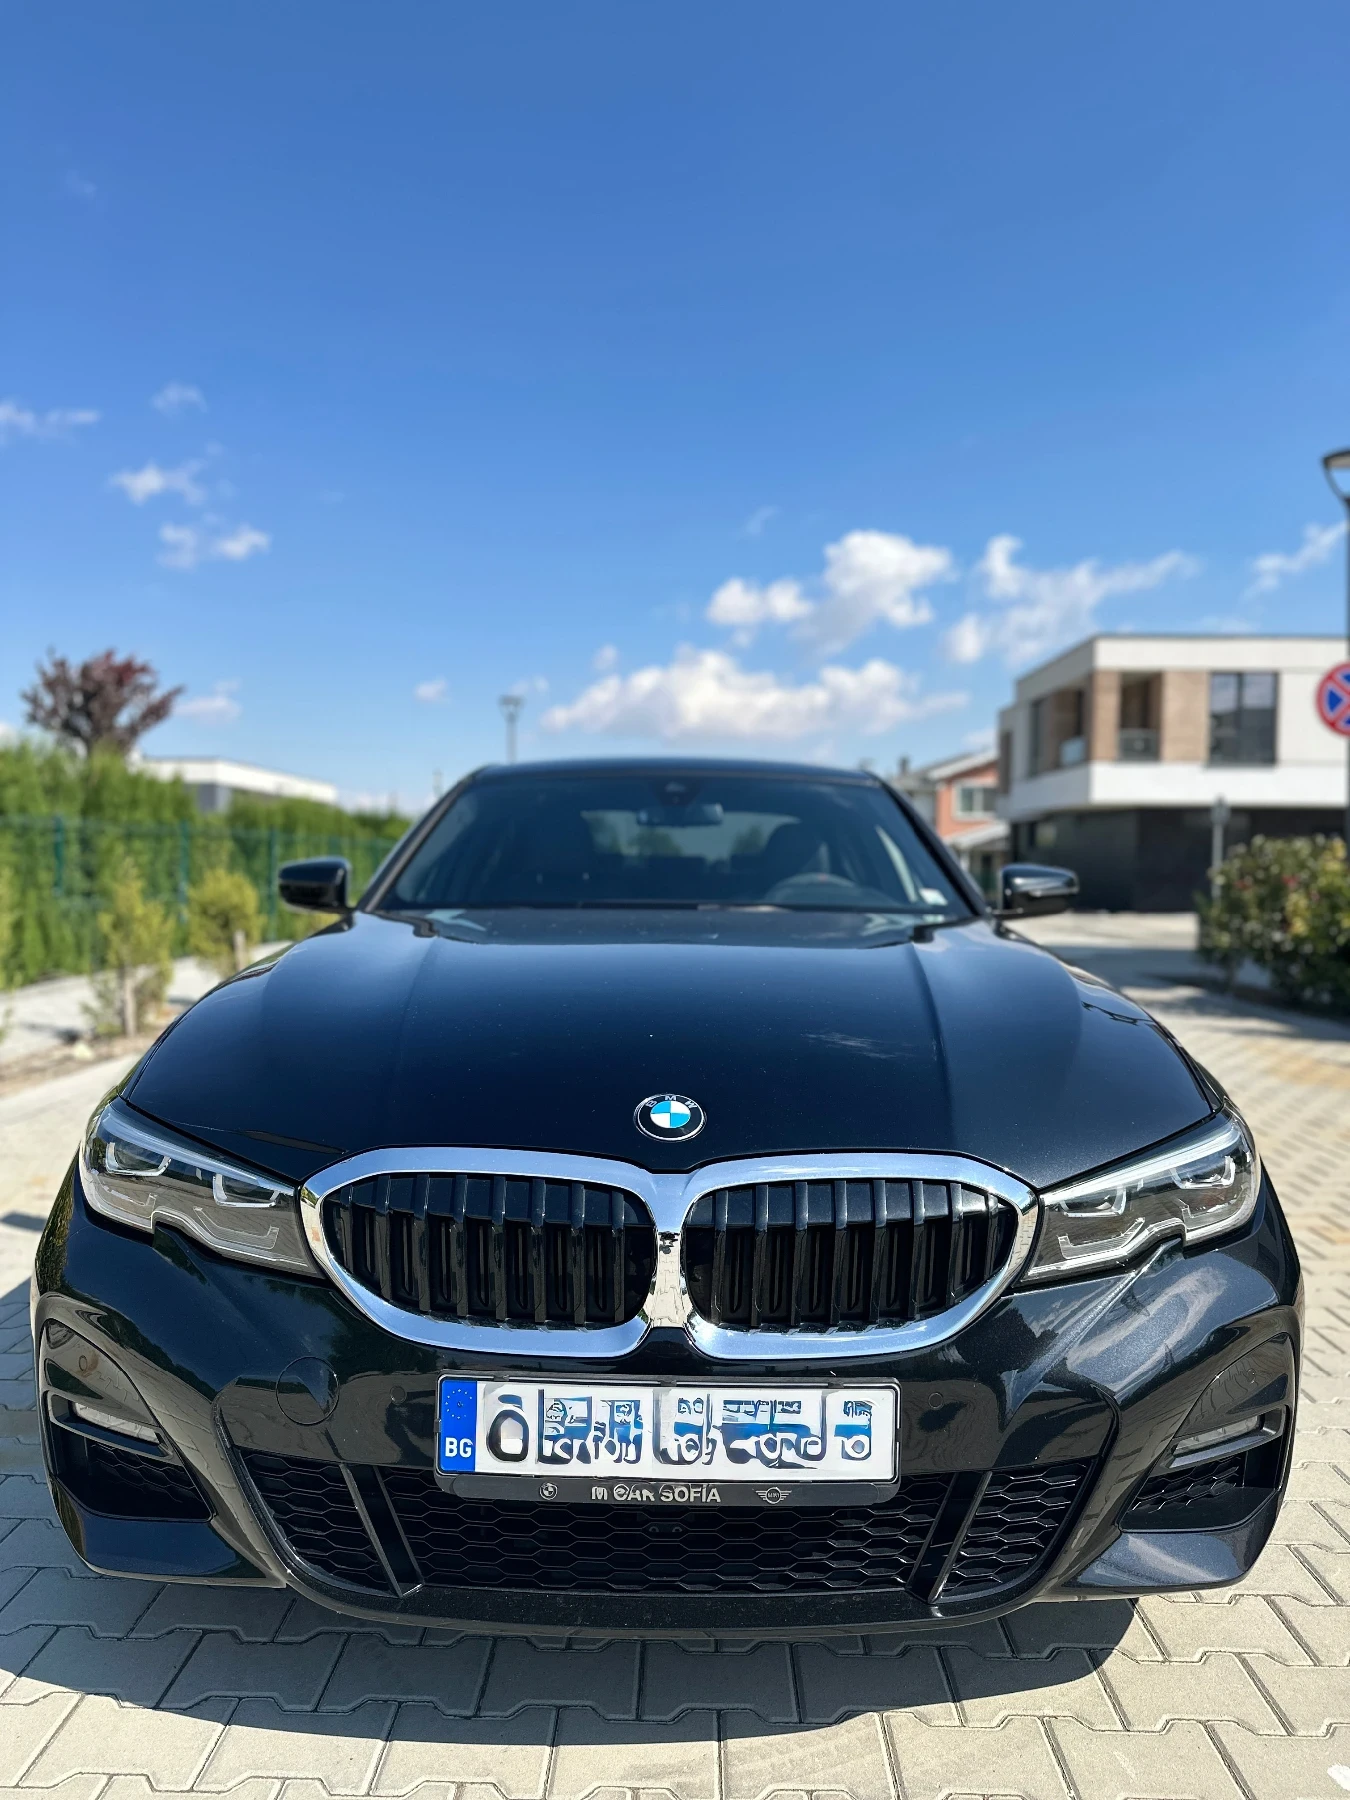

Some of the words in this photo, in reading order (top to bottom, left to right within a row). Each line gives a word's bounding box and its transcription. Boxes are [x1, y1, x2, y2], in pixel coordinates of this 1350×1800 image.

[645, 1095, 698, 1109] BMW
[445, 1437, 473, 1458] BG
[660, 1485, 721, 1502] SOFIA
